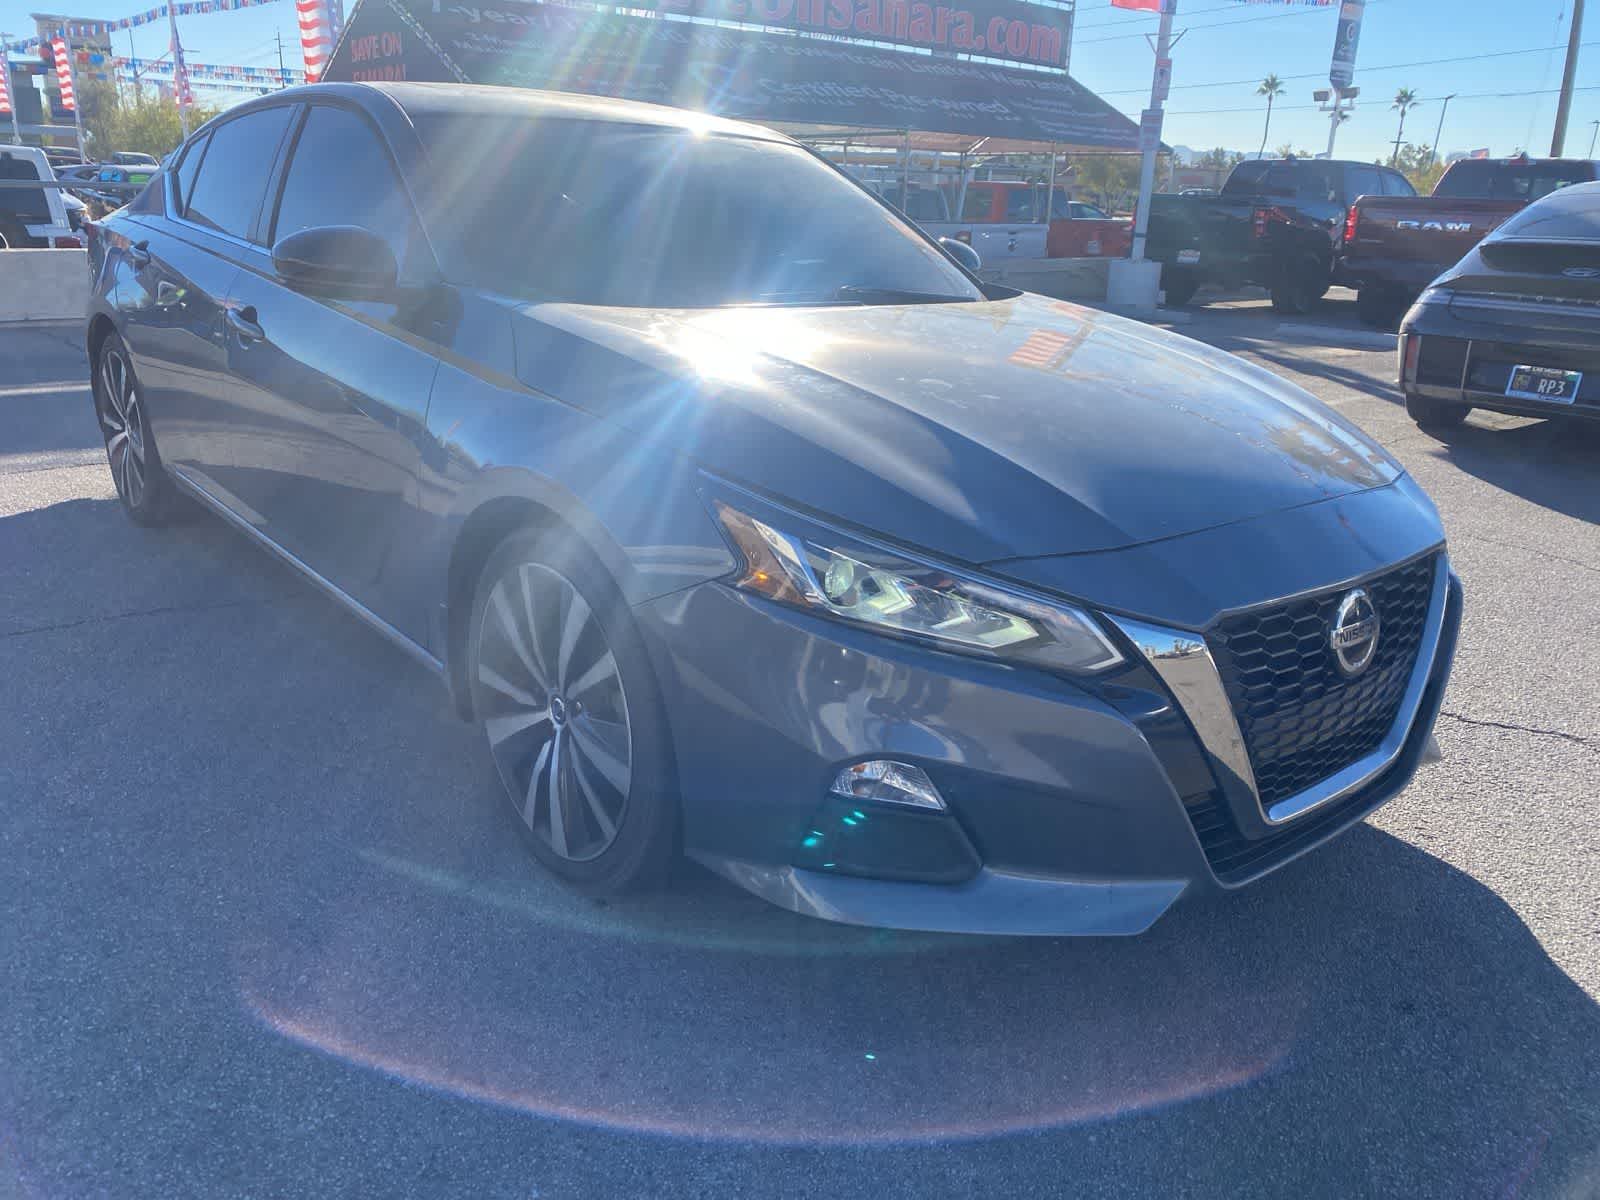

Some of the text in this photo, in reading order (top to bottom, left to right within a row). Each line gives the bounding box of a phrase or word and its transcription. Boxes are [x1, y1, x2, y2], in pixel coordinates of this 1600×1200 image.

[382, 32, 402, 57] ON
[1397, 220, 1471, 232] RAM
[1538, 379, 1566, 395] RP3
